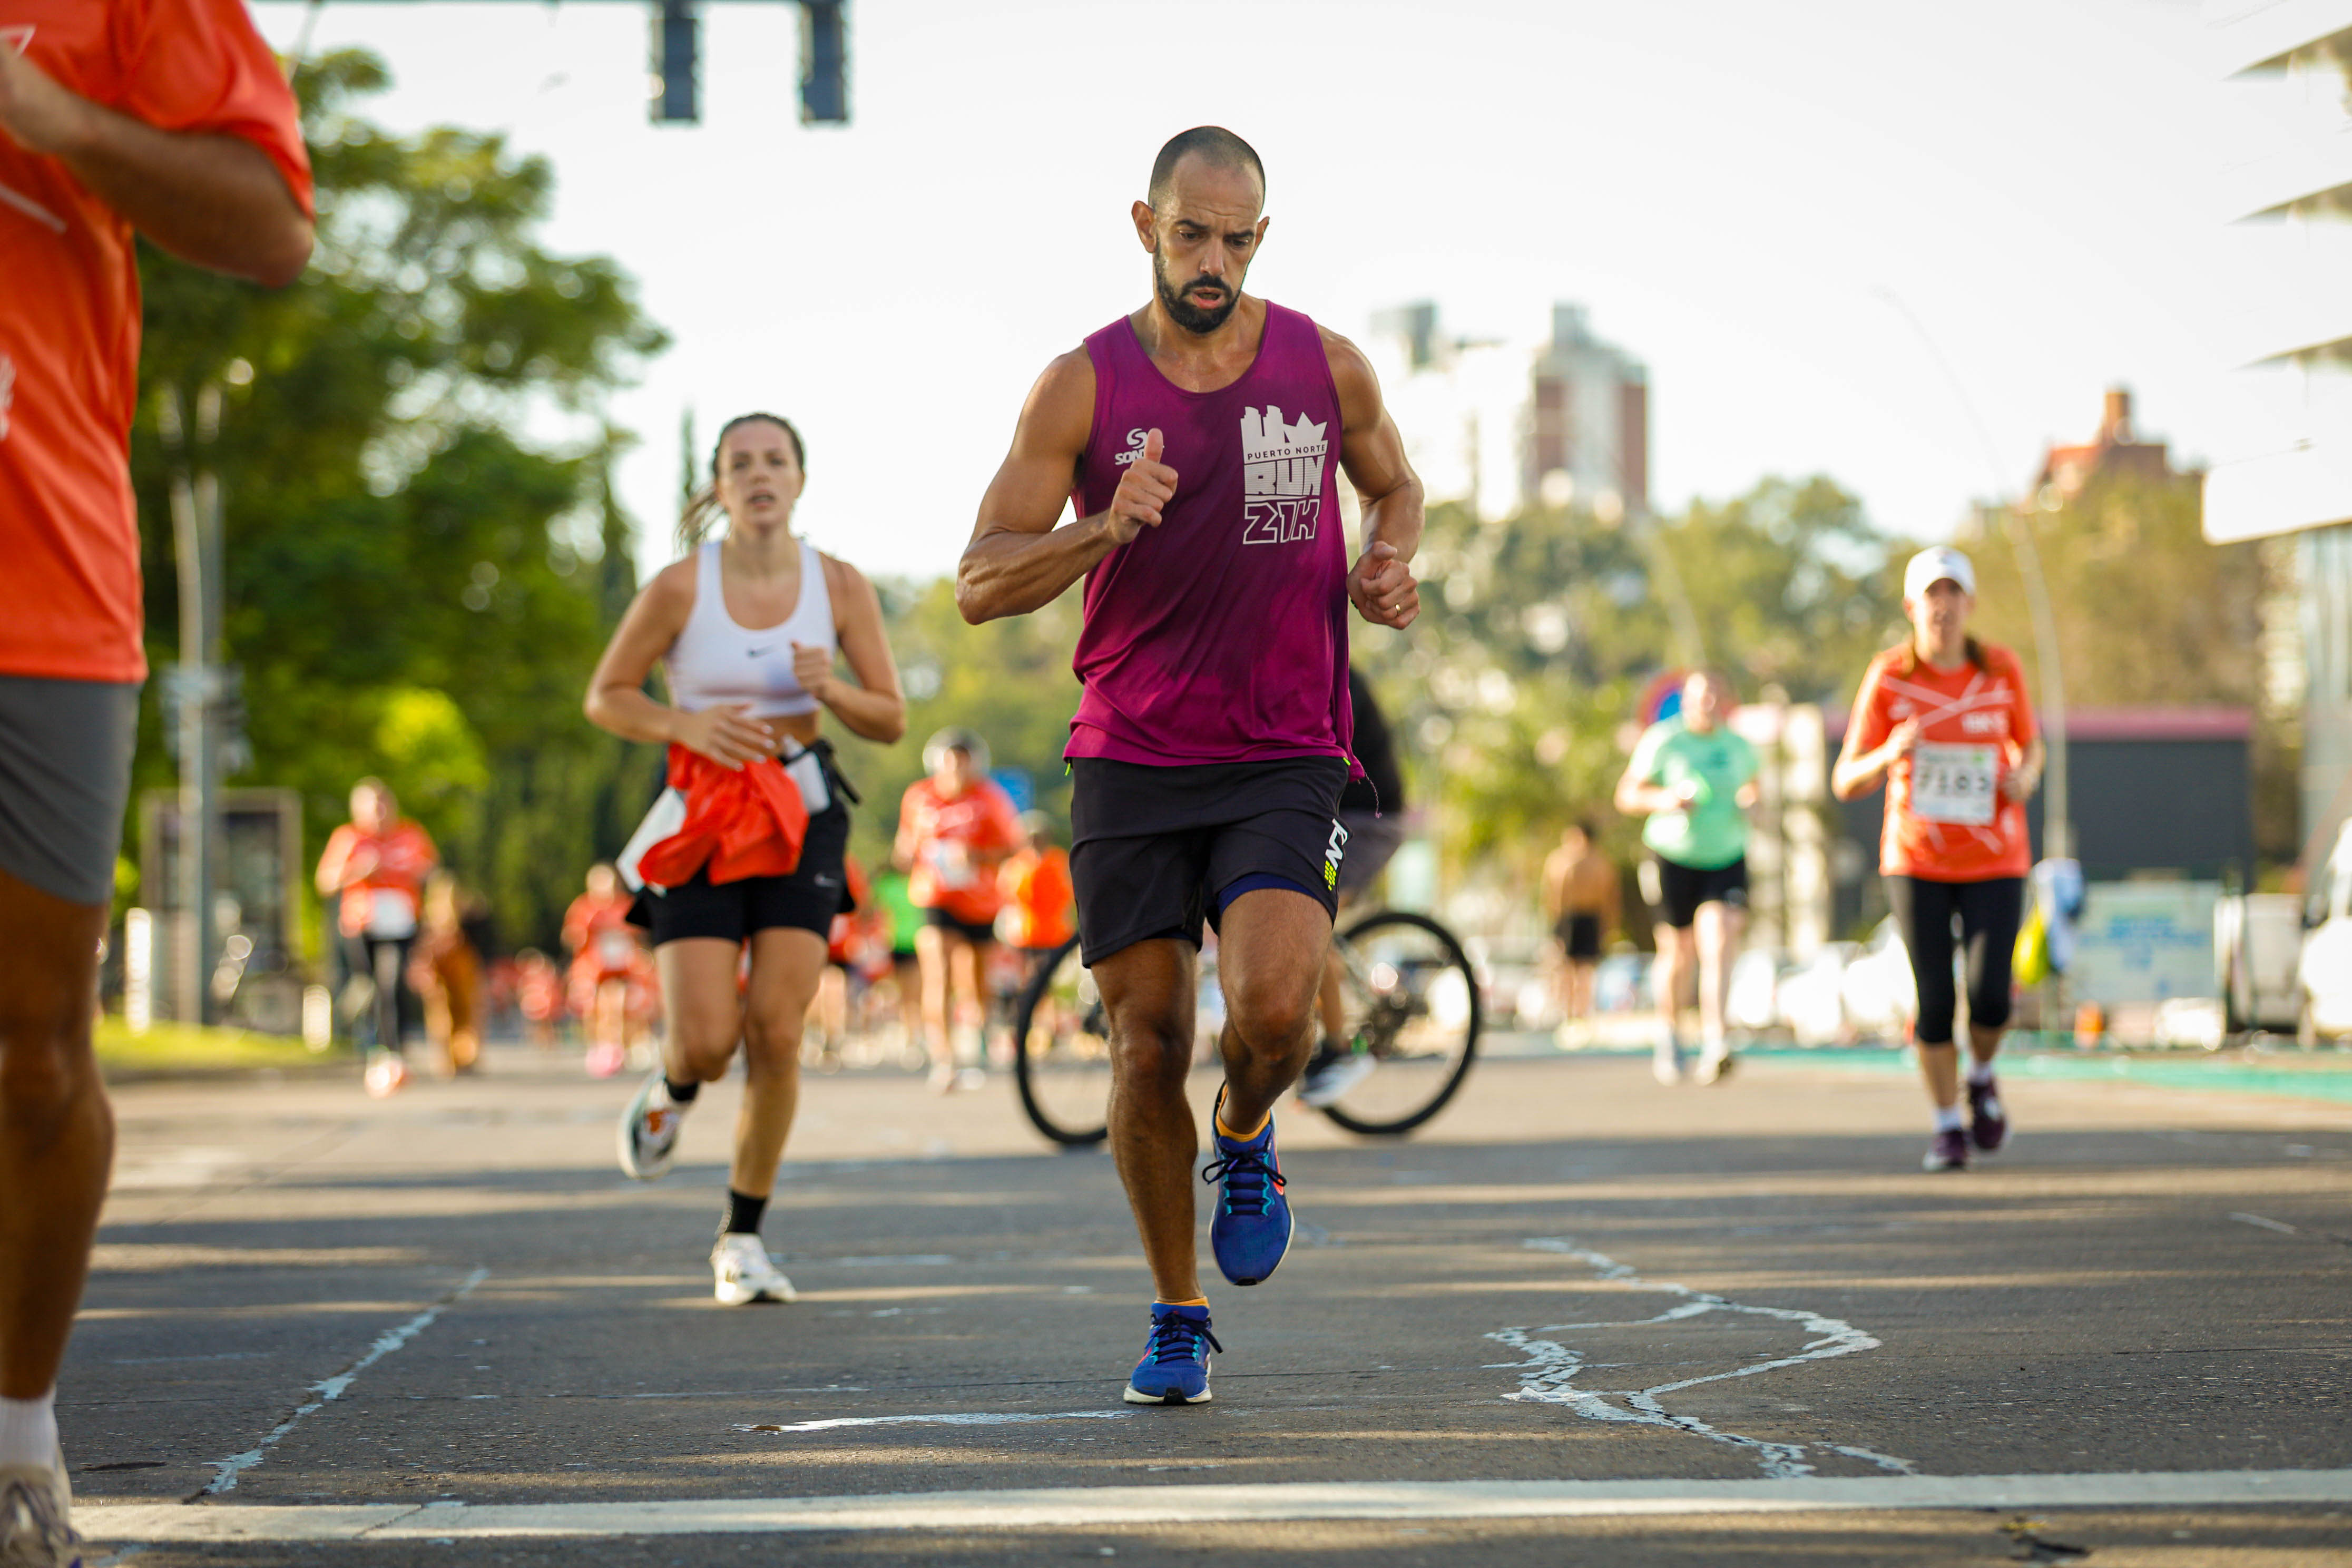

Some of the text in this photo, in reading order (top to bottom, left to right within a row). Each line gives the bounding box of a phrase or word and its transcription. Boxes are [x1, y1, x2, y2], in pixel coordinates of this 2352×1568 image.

[1114, 448, 1145, 465] SON
[1247, 444, 1325, 460] PUERTO NORTE
[1244, 455, 1326, 496] RUN
